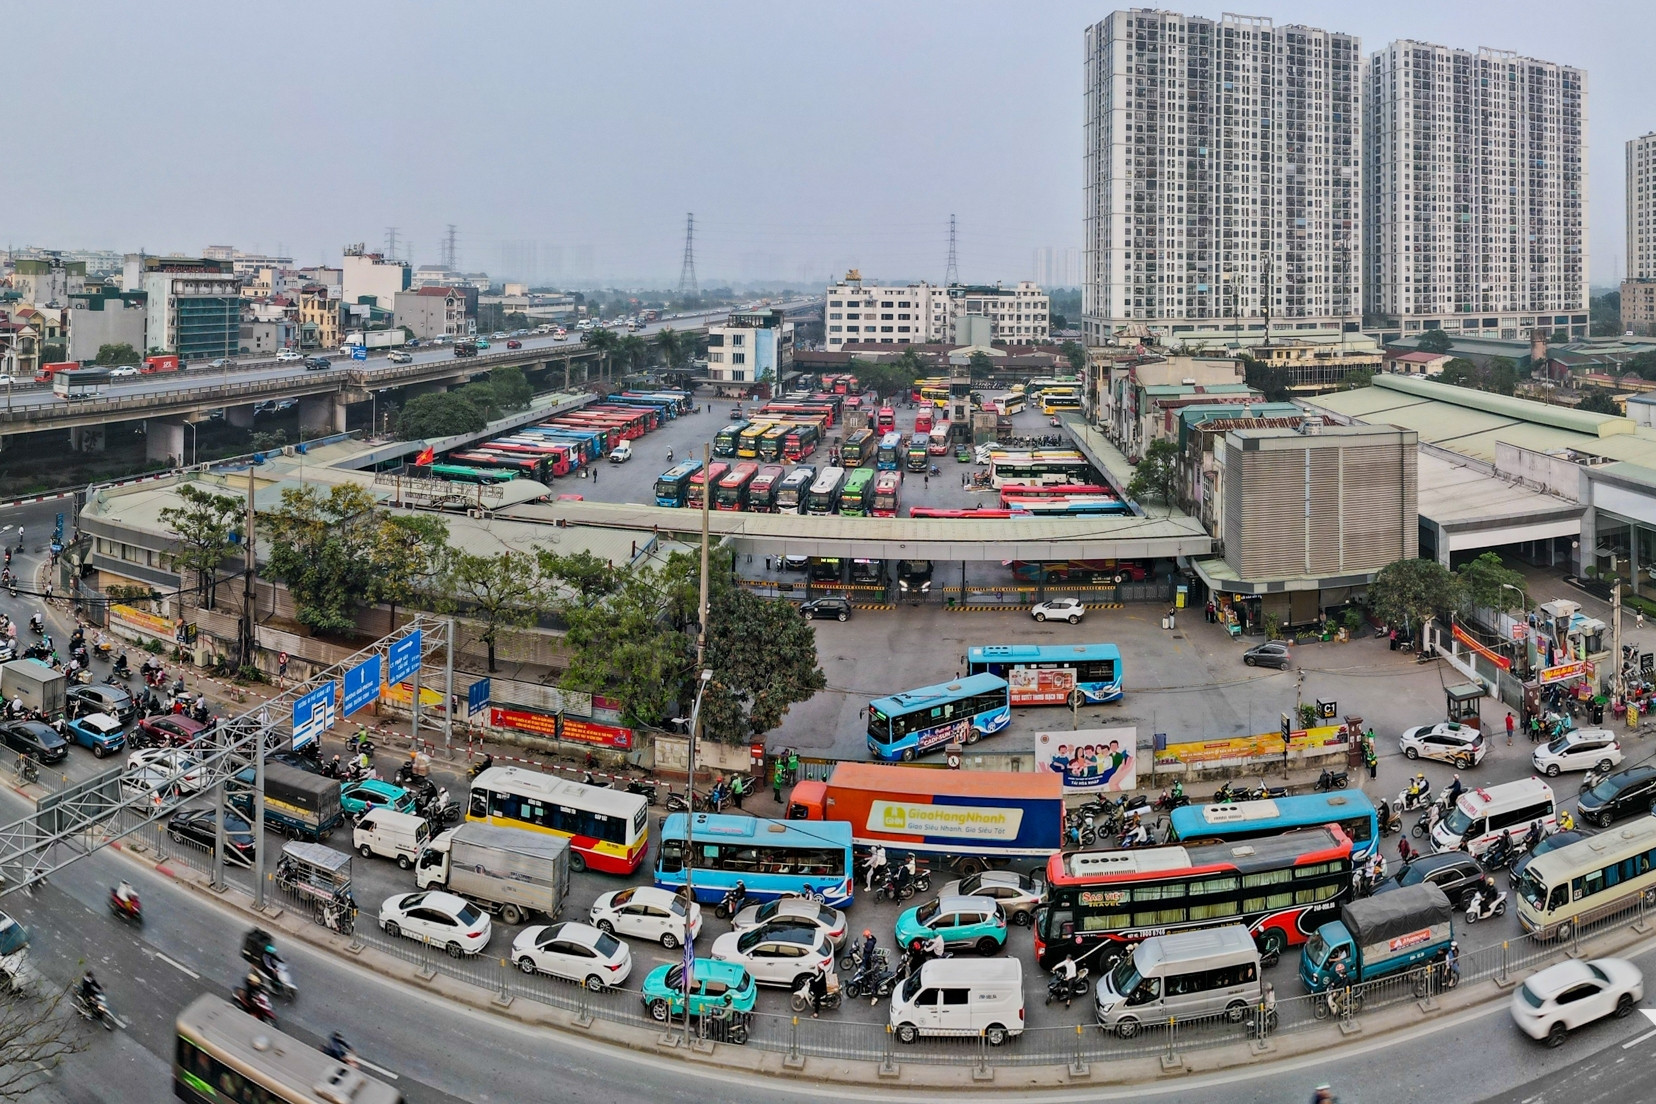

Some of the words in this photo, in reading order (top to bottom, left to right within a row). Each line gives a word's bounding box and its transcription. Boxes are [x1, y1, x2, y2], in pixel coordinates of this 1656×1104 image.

[1324, 704, 1335, 712] C1
[908, 808, 1006, 825] GiaoHangNhanh
[908, 822, 923, 830] Giao
